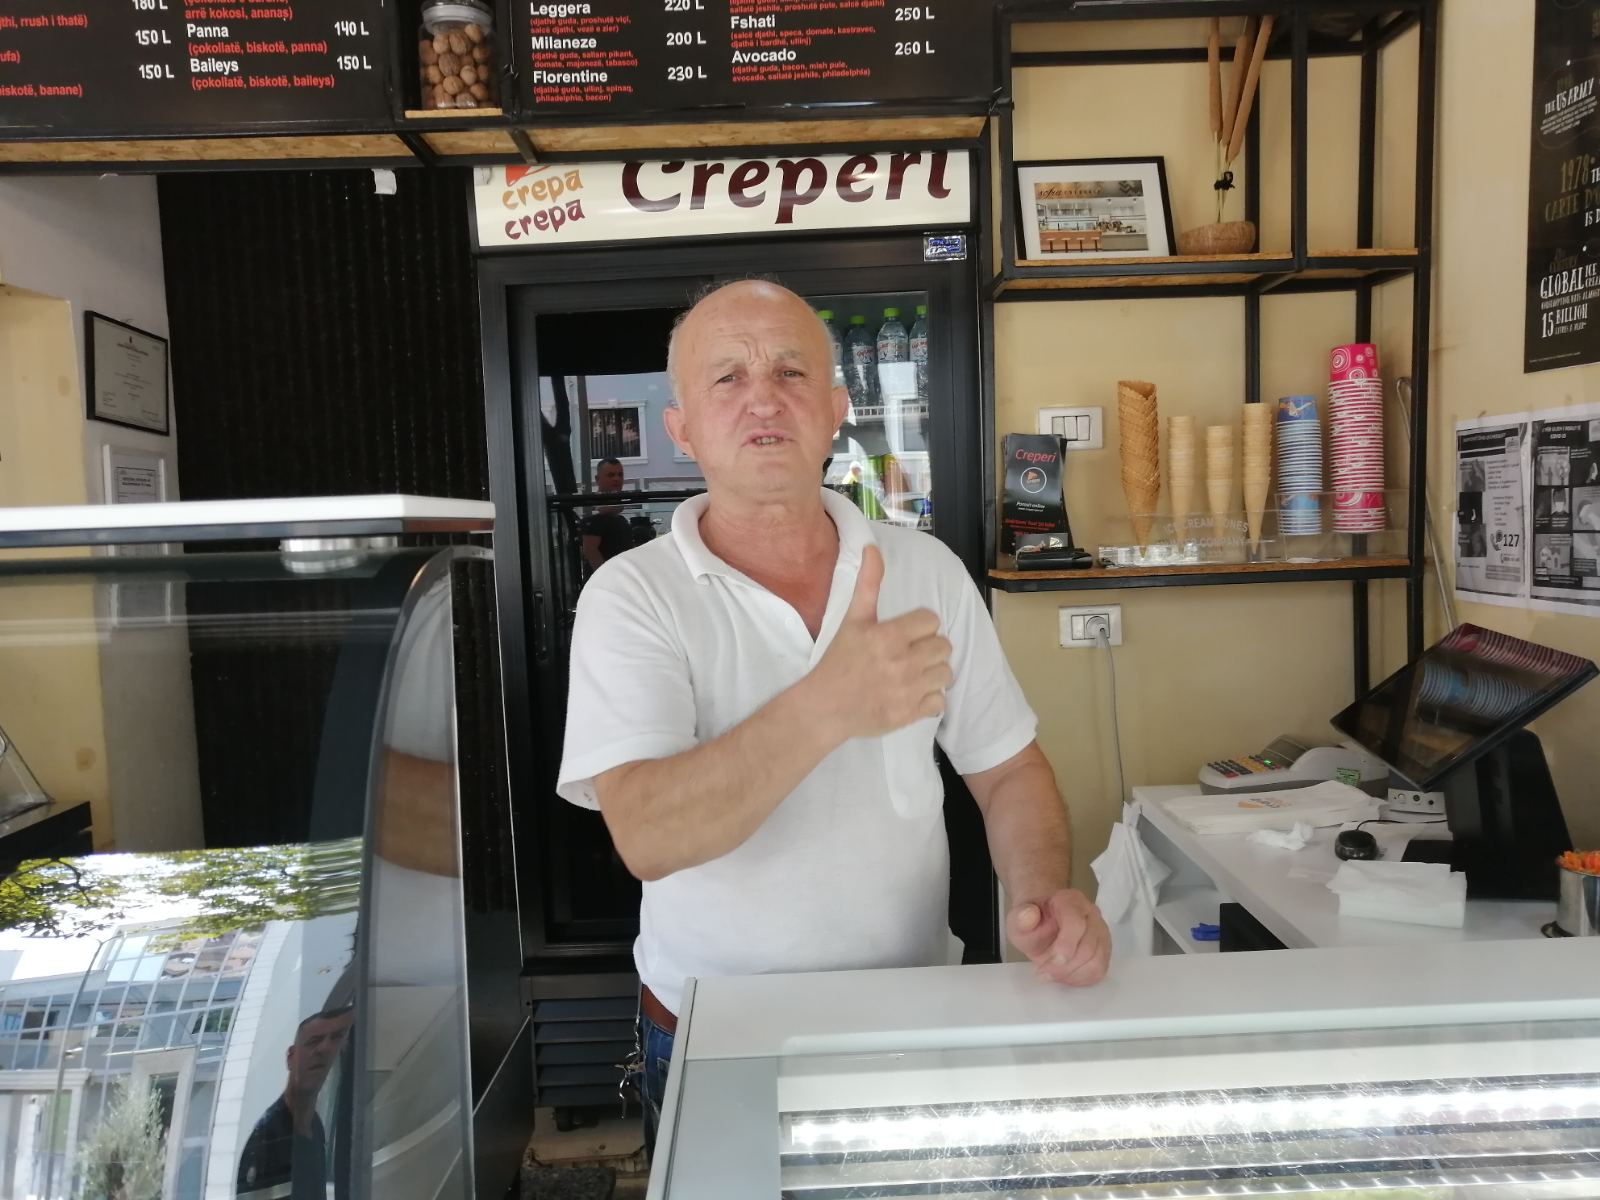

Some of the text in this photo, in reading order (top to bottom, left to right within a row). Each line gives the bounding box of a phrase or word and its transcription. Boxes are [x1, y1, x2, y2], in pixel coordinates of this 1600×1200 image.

[530, 2, 591, 17] Leggera
[695, 0, 705, 10] L
[185, 6, 293, 20] arrë kokosi, ananas)
[894, 7, 935, 21] 250 L
[20, 16, 48, 27] rrush
[57, 15, 88, 28] thatë)
[334, 21, 370, 36] 140 L
[730, 14, 776, 29] Fshati
[135, 29, 171, 45] 150 L
[186, 24, 230, 38] Panna
[666, 31, 707, 46] 200 L
[246, 41, 288, 54] biskotë,
[291, 41, 328, 55] panna)
[531, 36, 598, 50] Milaneze
[894, 41, 935, 56] 260 L
[336, 56, 372, 70] 150 L
[731, 48, 797, 64] Avocado
[138, 64, 175, 79] 150 L
[190, 58, 240, 75] Baileys
[667, 65, 708, 81] 230 L
[249, 76, 291, 89] biskotë,
[294, 75, 335, 89] baileys)
[533, 69, 608, 84] Florentine
[39, 84, 83, 98] banane)
[1567, 77, 1595, 107] ARMY
[502, 169, 584, 210] crepa
[621, 152, 952, 224] Creperi
[505, 199, 586, 240] crepa
[1540, 267, 1585, 299] GLOBAL
[1542, 303, 1588, 338] 15 BILLION
[1015, 449, 1057, 463] Creperi
[1503, 534, 1520, 548] 127
